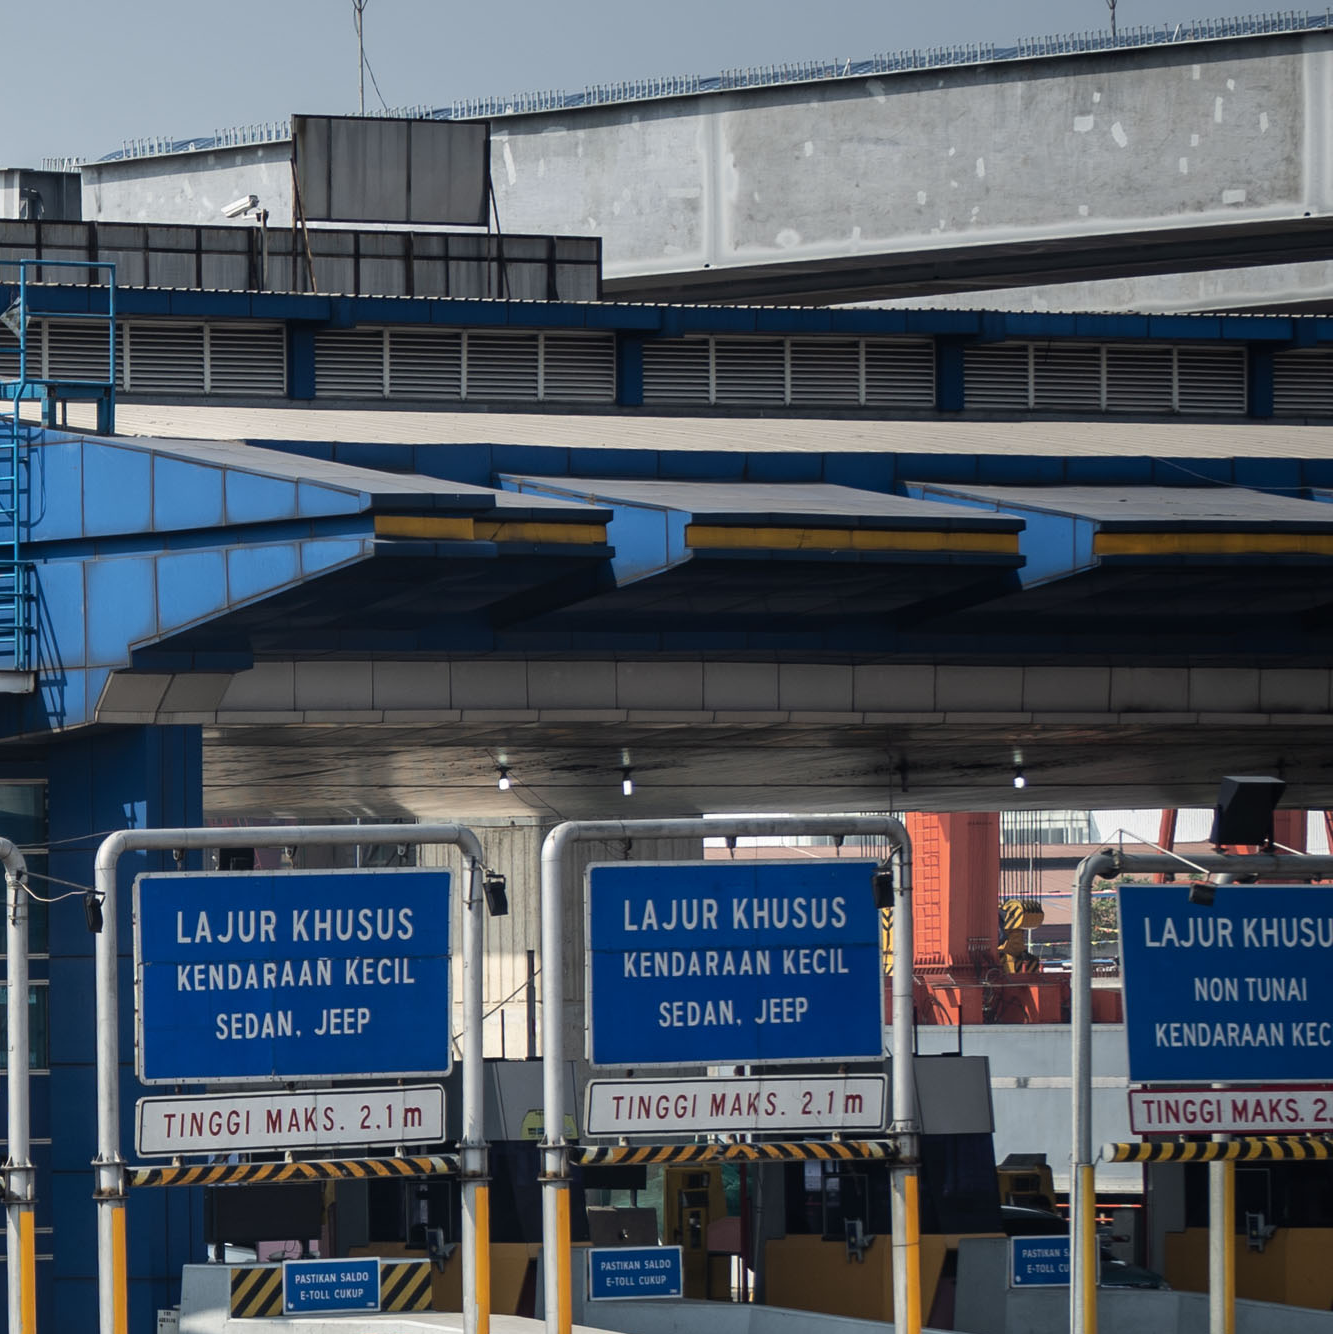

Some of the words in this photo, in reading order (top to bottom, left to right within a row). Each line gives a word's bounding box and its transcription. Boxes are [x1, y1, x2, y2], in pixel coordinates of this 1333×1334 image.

[178, 911, 276, 943] LAJUR
[293, 908, 413, 941] KHUSUS
[625, 899, 717, 930] LAJUR
[733, 897, 845, 928] KHUSUS
[1145, 918, 1233, 947] LAJUR
[1244, 918, 1333, 947] KHUSU
[178, 958, 331, 991] KENDARAAN
[346, 958, 414, 984] KECIL
[625, 951, 770, 977] KENDARAAN
[784, 949, 848, 974] KECIL
[1195, 978, 1238, 1001] NON
[1245, 978, 1306, 1001] TUNAI
[216, 1011, 301, 1039] SEDAN,
[315, 1008, 370, 1035] JEEP
[659, 1000, 741, 1027] SEDAN,
[755, 998, 807, 1024] JEEP
[1156, 1023, 1283, 1046] KENDARAAN
[1293, 1022, 1330, 1046] KEC
[613, 1095, 696, 1119] TINGGI
[710, 1092, 784, 1116] MAKS.
[1142, 1099, 1221, 1123] TINGGI
[1232, 1099, 1304, 1122] MAKS.
[164, 1110, 249, 1138] TINGGI
[267, 1107, 344, 1133] MAKS.
[295, 1274, 336, 1284] PASTIKAN
[341, 1272, 368, 1282] SALDO
[601, 1261, 640, 1270] PASTIKAN
[644, 1259, 671, 1269] SALDO
[606, 1277, 635, 1286] E-TOLL
[639, 1275, 666, 1285] CUKUP
[301, 1291, 330, 1300] E-TOLL
[335, 1289, 363, 1298] CUKUP
